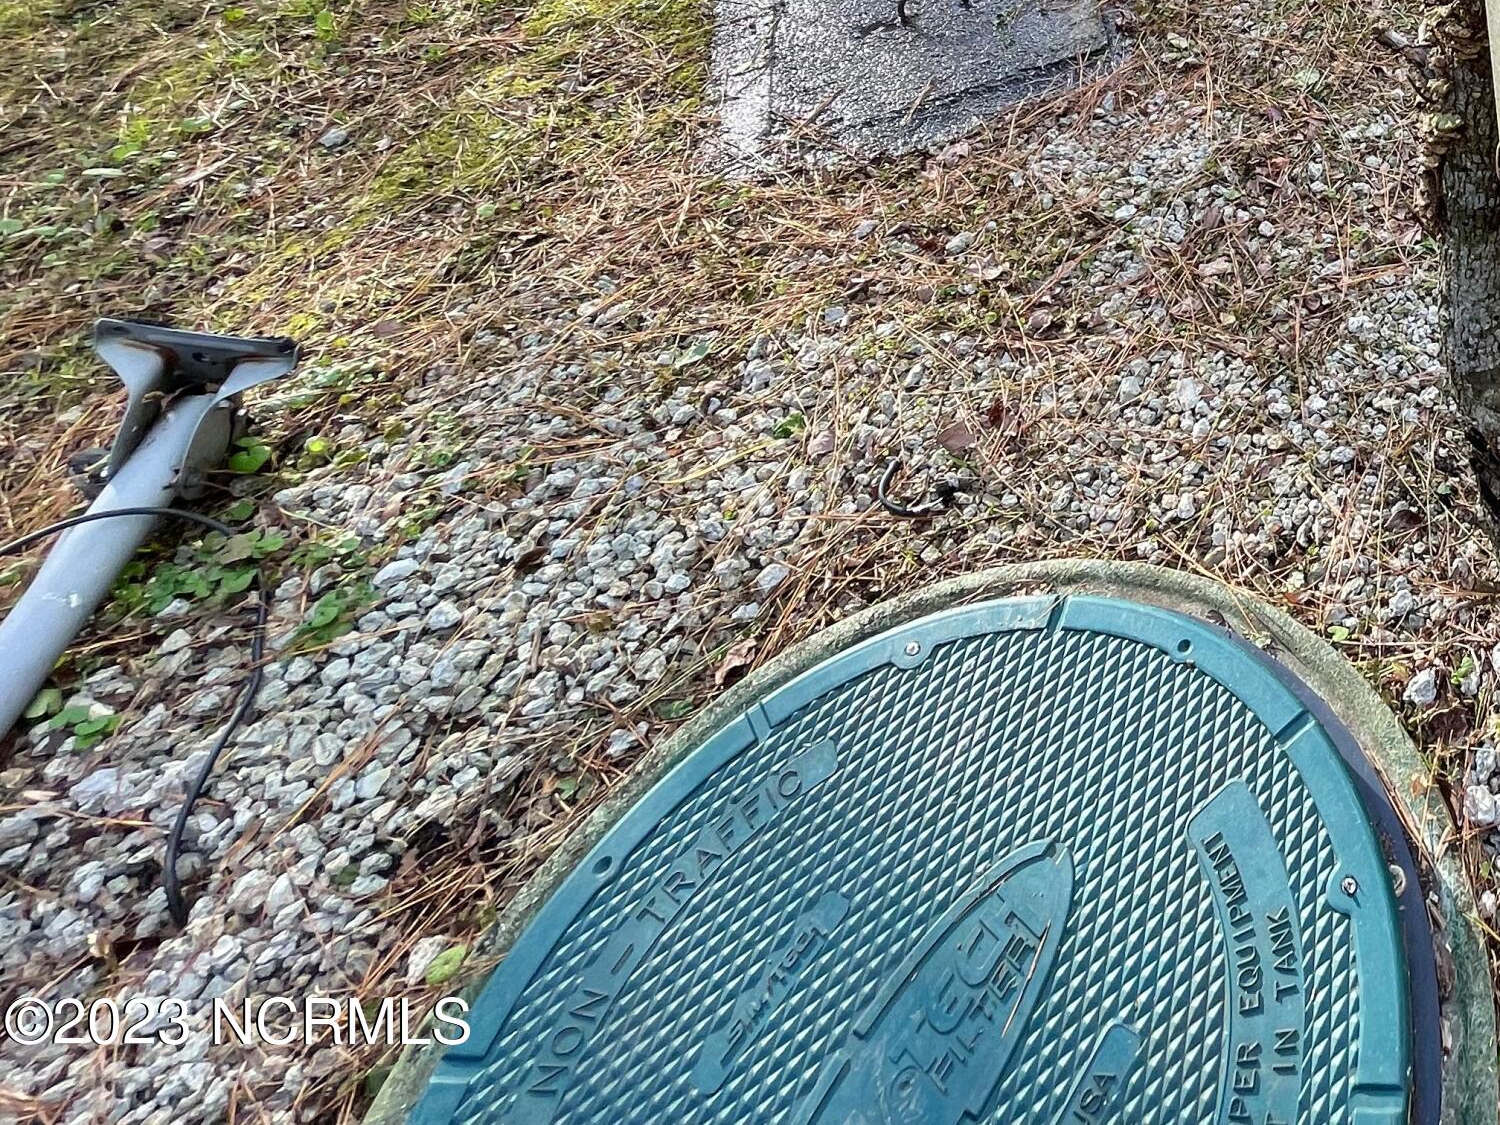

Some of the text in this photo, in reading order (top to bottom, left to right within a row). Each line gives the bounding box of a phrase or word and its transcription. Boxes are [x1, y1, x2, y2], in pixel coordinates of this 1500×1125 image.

[528, 989, 609, 1098] NON
[636, 770, 803, 925] TRAFFIC
[1200, 831, 1264, 1017] EQUIPMENT
[1266, 905, 1300, 1004] TANK
[1273, 1027, 1300, 1076] IN
